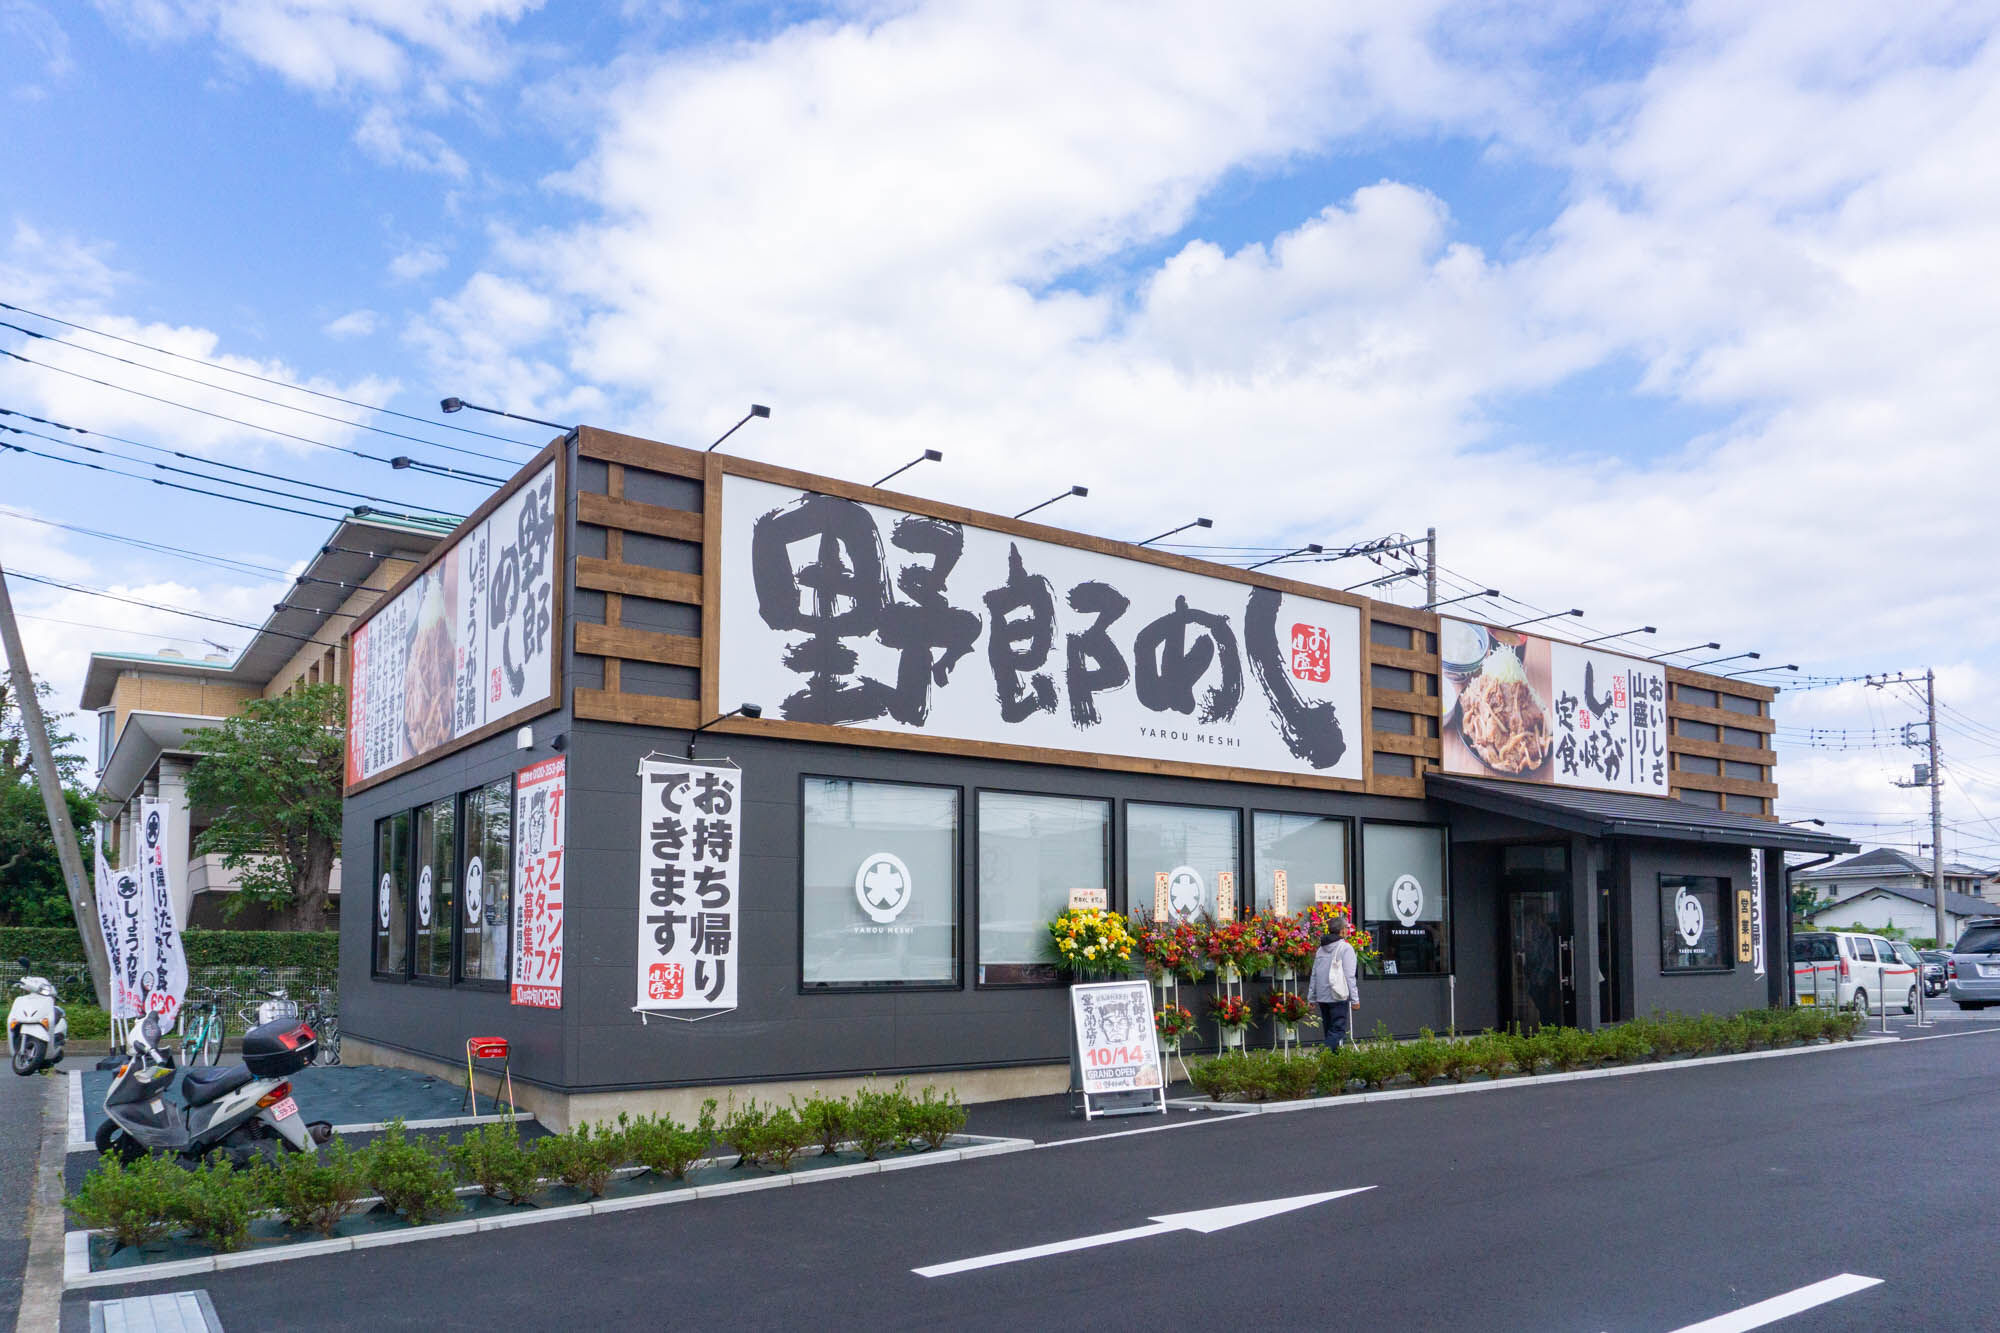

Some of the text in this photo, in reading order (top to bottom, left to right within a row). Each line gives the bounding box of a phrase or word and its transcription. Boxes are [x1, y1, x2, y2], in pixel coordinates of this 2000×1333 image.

[491, 540, 524, 698] めし
[518, 472, 555, 665] 野郎
[751, 491, 1347, 770] 野郎めし
[1140, 727, 1241, 748] YAROU MESHI
[1555, 689, 1579, 777] 定食
[1649, 675, 1665, 786] おいしさ
[156, 867, 173, 949] 揚げたて
[534, 857, 549, 981] スタッフ
[547, 783, 565, 983] オープニング
[646, 773, 691, 956] できます
[690, 772, 734, 1003] お持ち帰り
[854, 927, 914, 935] YAROU MESHI
[1087, 1045, 1145, 1067] 10/14
[1087, 1067, 1136, 1079] GRAND OPEN
